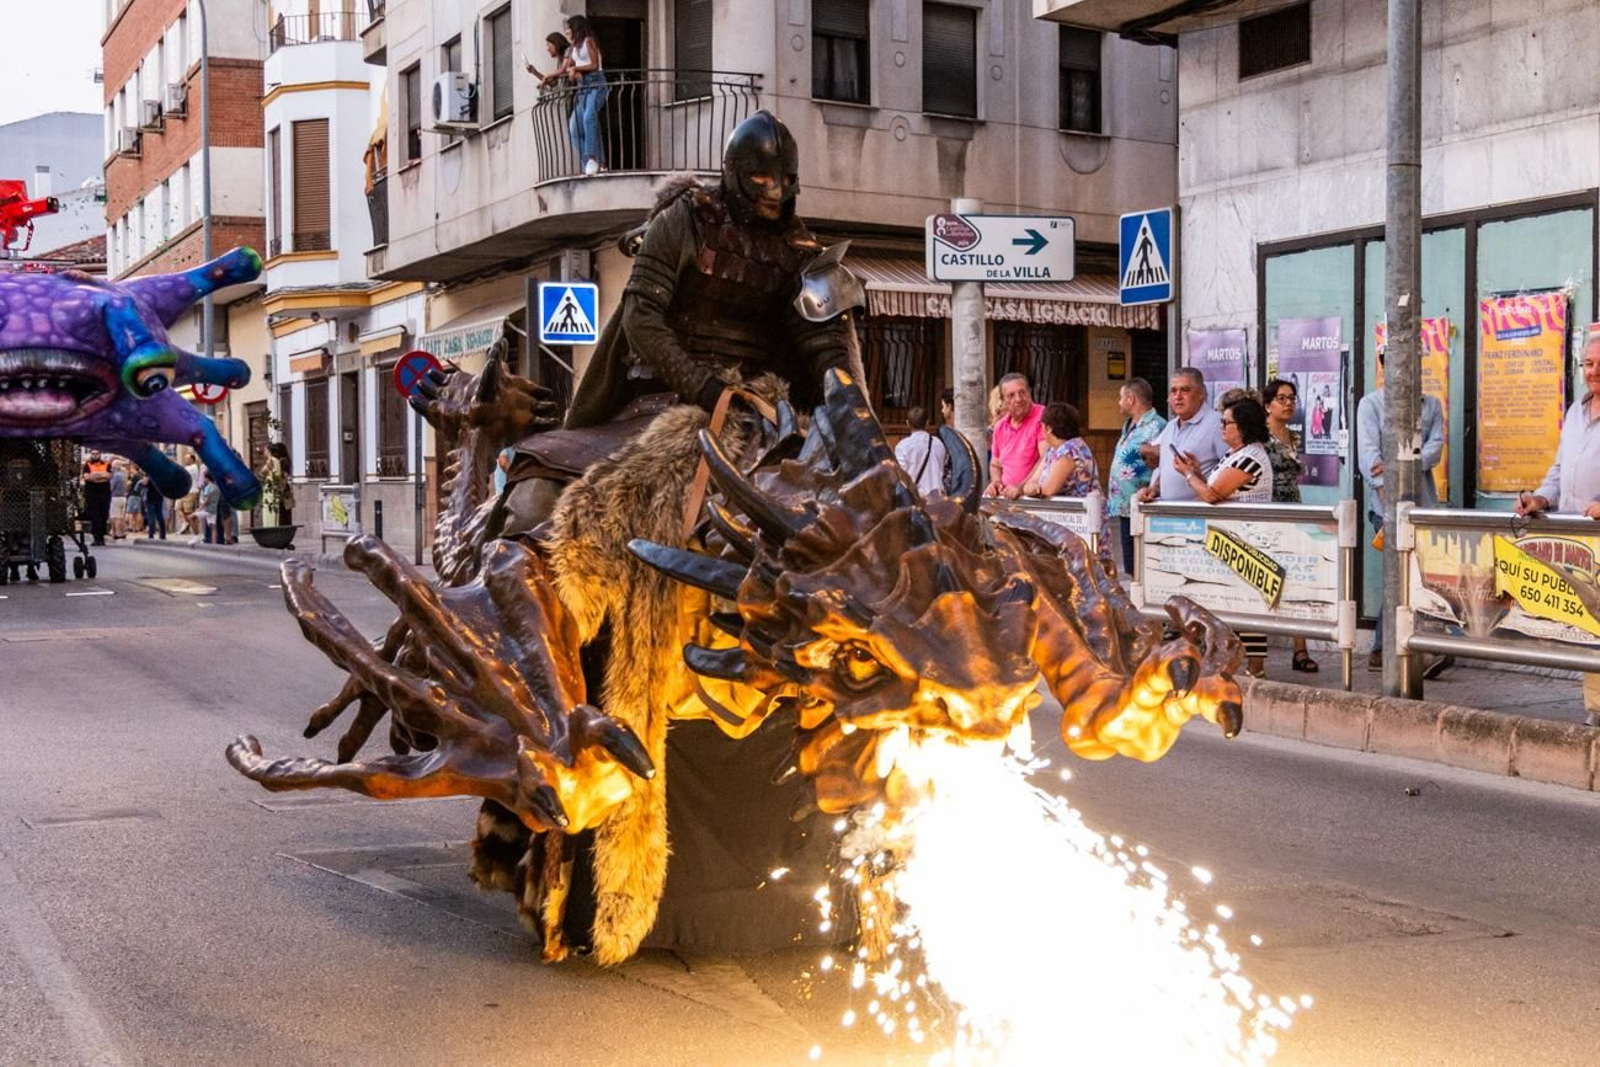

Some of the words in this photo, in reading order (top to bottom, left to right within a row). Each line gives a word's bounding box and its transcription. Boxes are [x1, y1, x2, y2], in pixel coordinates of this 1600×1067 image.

[941, 254, 1005, 265] CASTILLO
[986, 270, 998, 278] DE
[1000, 270, 1011, 278] LA
[1013, 267, 1051, 278] VILLA
[984, 301, 1029, 320] CASA
[1033, 302, 1108, 324] IGNACIO
[1302, 336, 1339, 350] MARTOS
[1207, 347, 1241, 361] MARTOS
[1211, 533, 1279, 597] DISPONIBLE
[1523, 566, 1539, 583] SU
[1520, 585, 1541, 602] 650
[1544, 594, 1560, 609] 411
[1562, 598, 1584, 618] 354
